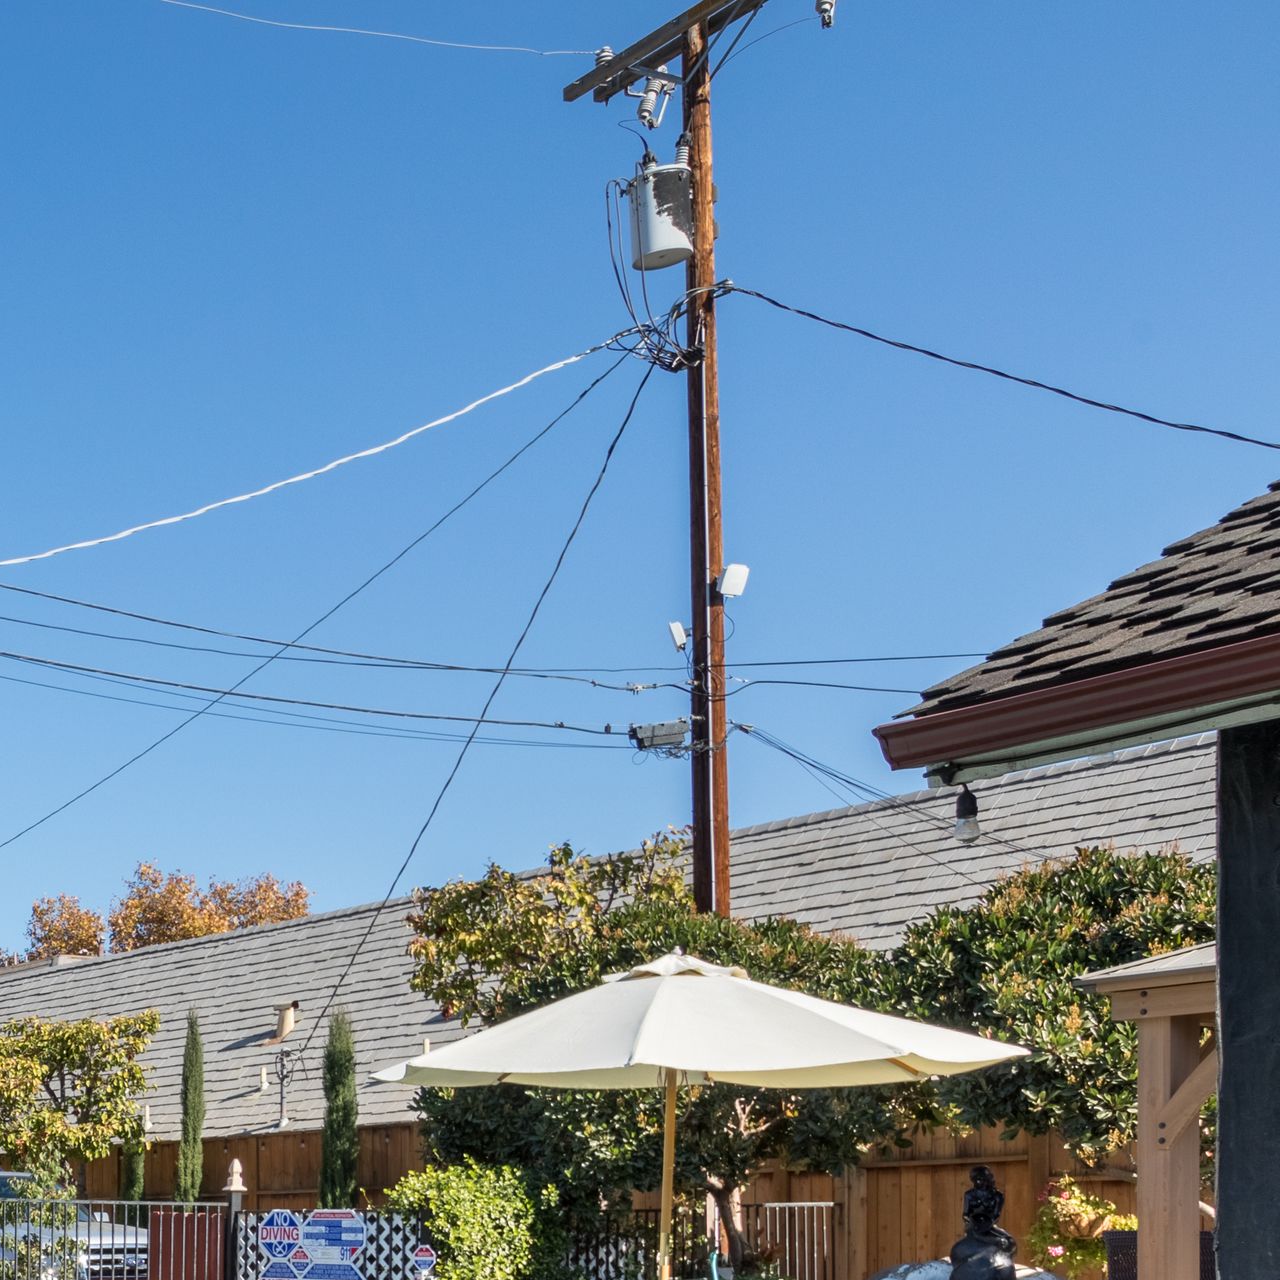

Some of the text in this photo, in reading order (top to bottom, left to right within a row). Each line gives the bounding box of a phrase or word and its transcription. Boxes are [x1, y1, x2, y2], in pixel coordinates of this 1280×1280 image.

[273, 1212, 290, 1226] NO
[261, 1227, 299, 1240] DIVING
[340, 1246, 351, 1260] 911
